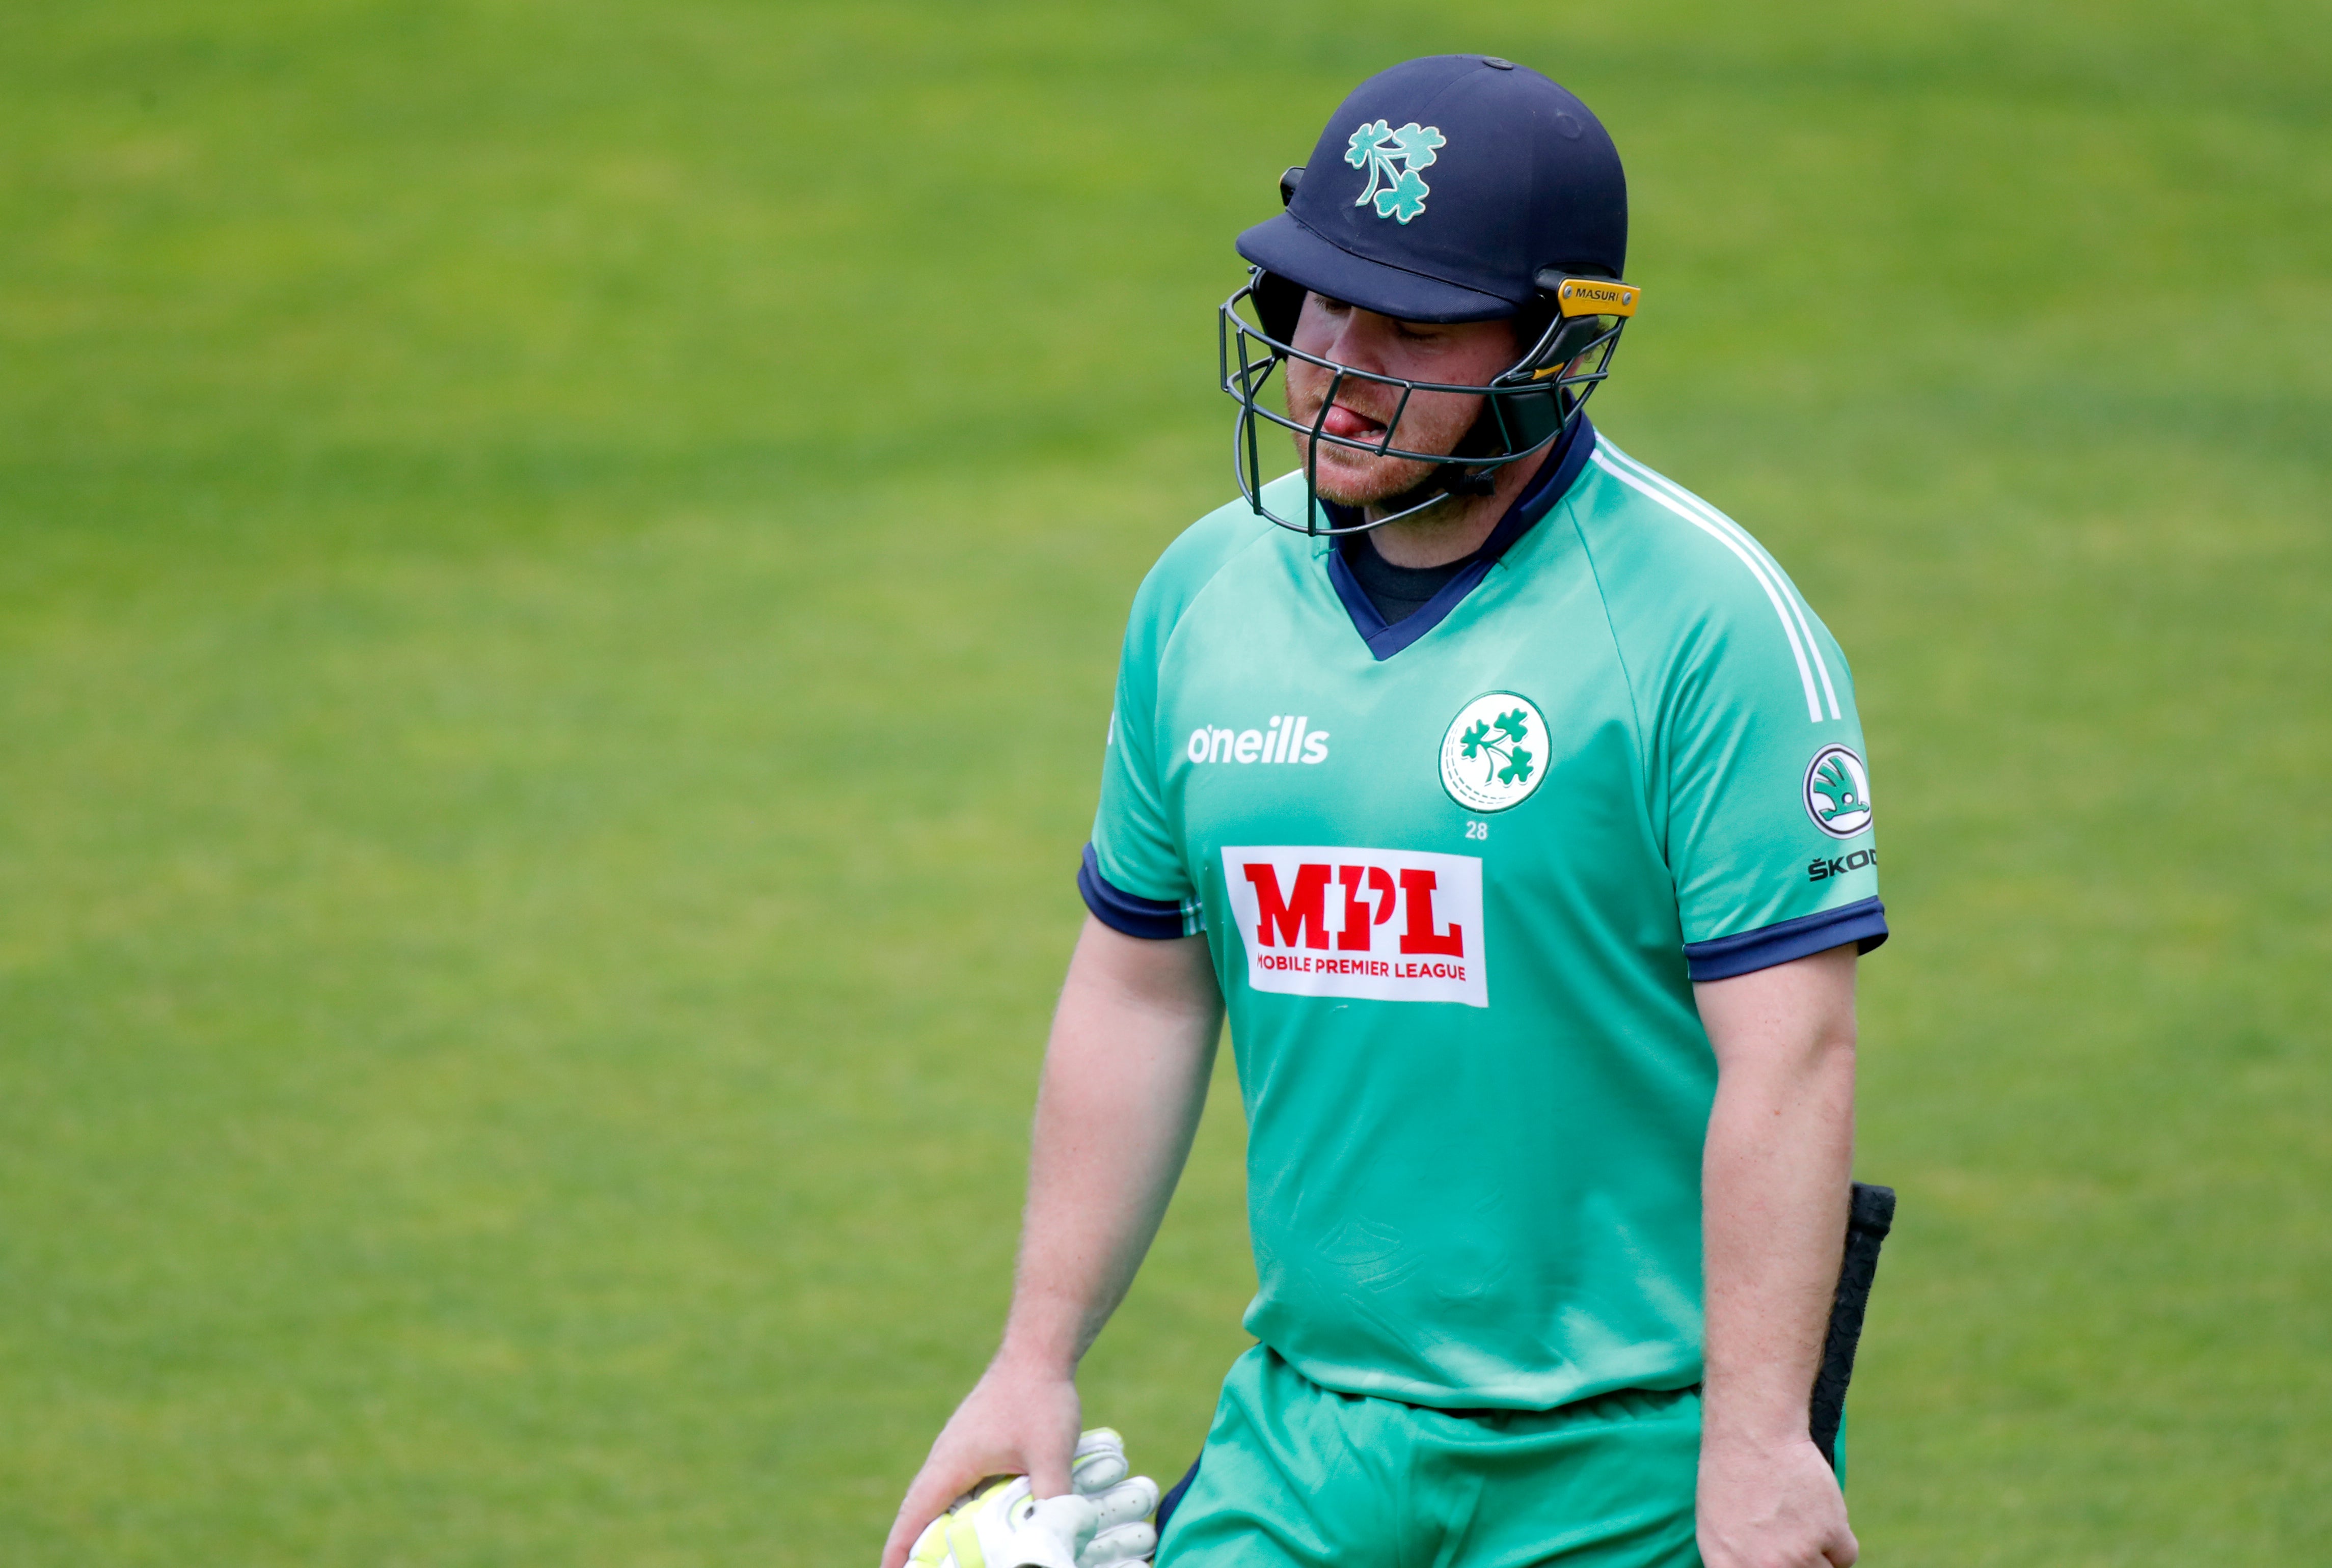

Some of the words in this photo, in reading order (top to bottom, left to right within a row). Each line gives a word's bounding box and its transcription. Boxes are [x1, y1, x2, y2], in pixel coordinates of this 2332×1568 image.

[1576, 288, 1619, 301] MASURI
[1465, 820, 1488, 840] 28
[1242, 863, 1465, 959] MPL
[1257, 952, 1311, 973] MOBILE
[1315, 958, 1389, 977] PREMIER
[1395, 962, 1467, 982] LEAGUE
